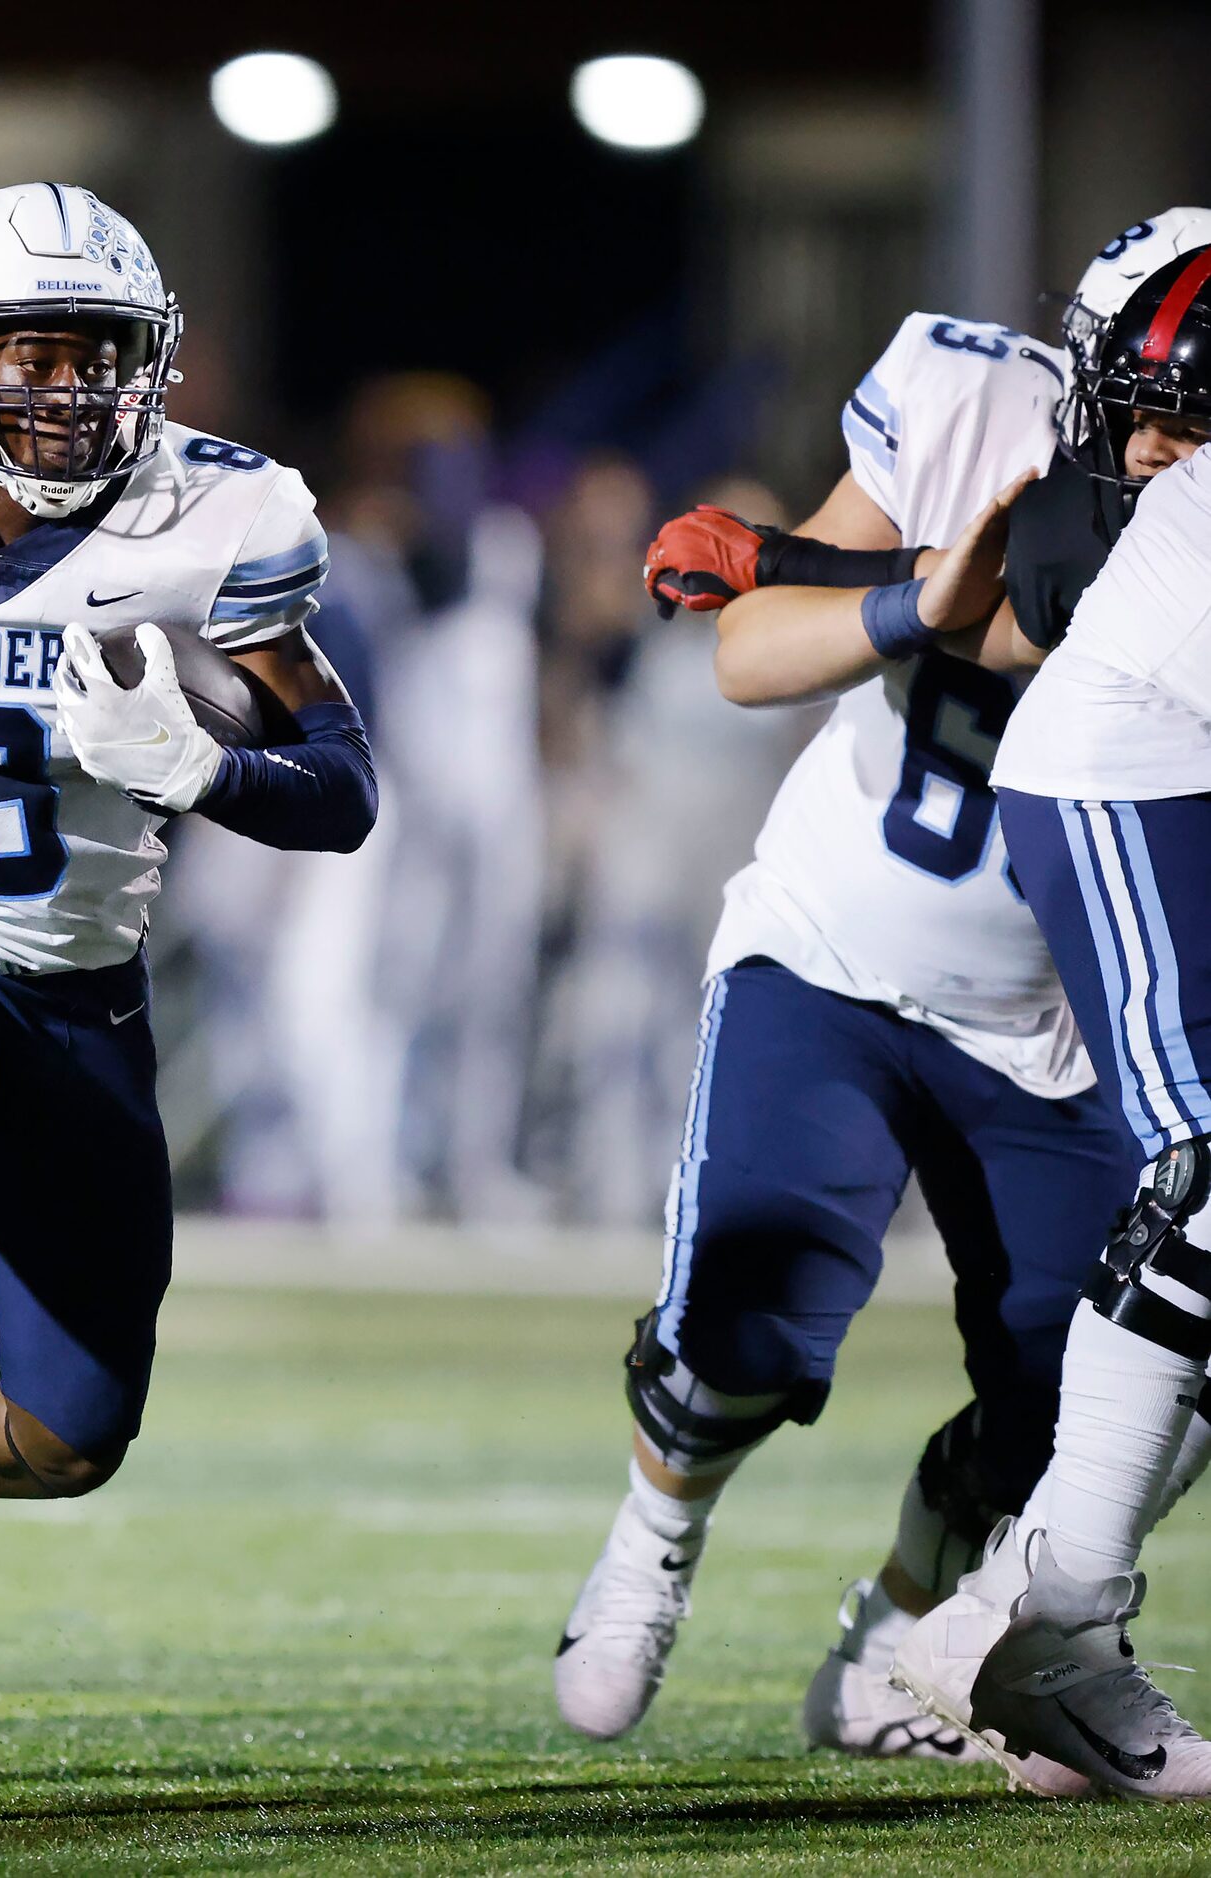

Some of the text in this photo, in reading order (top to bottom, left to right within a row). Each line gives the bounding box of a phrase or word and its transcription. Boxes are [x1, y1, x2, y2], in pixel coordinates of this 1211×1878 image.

[37, 280, 103, 292] BELLieve
[180, 437, 273, 475] 8
[40, 484, 75, 495] Riddell
[879, 648, 1029, 906] 6
[1039, 1663, 1081, 1686] ALPHA
